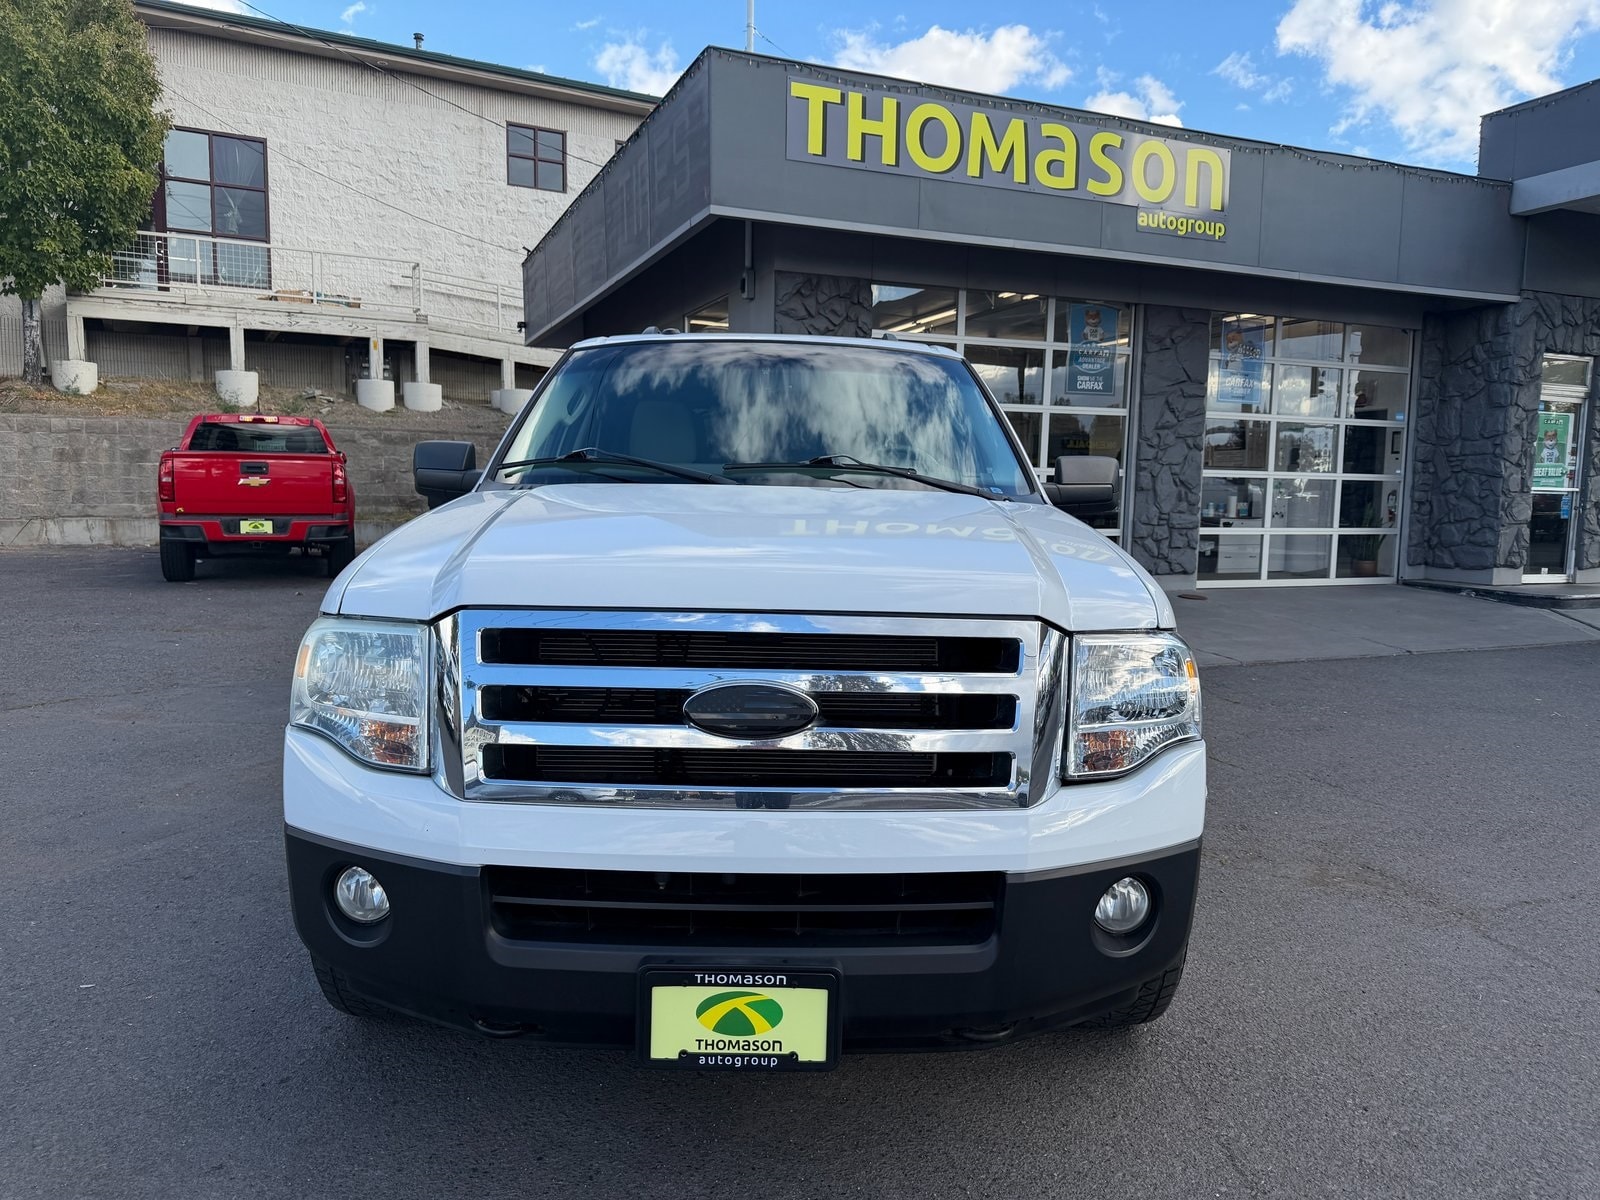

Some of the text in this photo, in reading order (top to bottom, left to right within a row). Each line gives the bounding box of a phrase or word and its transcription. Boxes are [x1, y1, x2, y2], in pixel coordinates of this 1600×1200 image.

[790, 81, 1226, 211] THOMason
[1137, 210, 1226, 240] autogroup
[1077, 381, 1104, 390] CARFAX
[1226, 377, 1254, 388] CARFAX
[694, 973, 787, 986] THOMason
[695, 1038, 783, 1052] THOMason
[698, 1054, 778, 1067] autogroup
